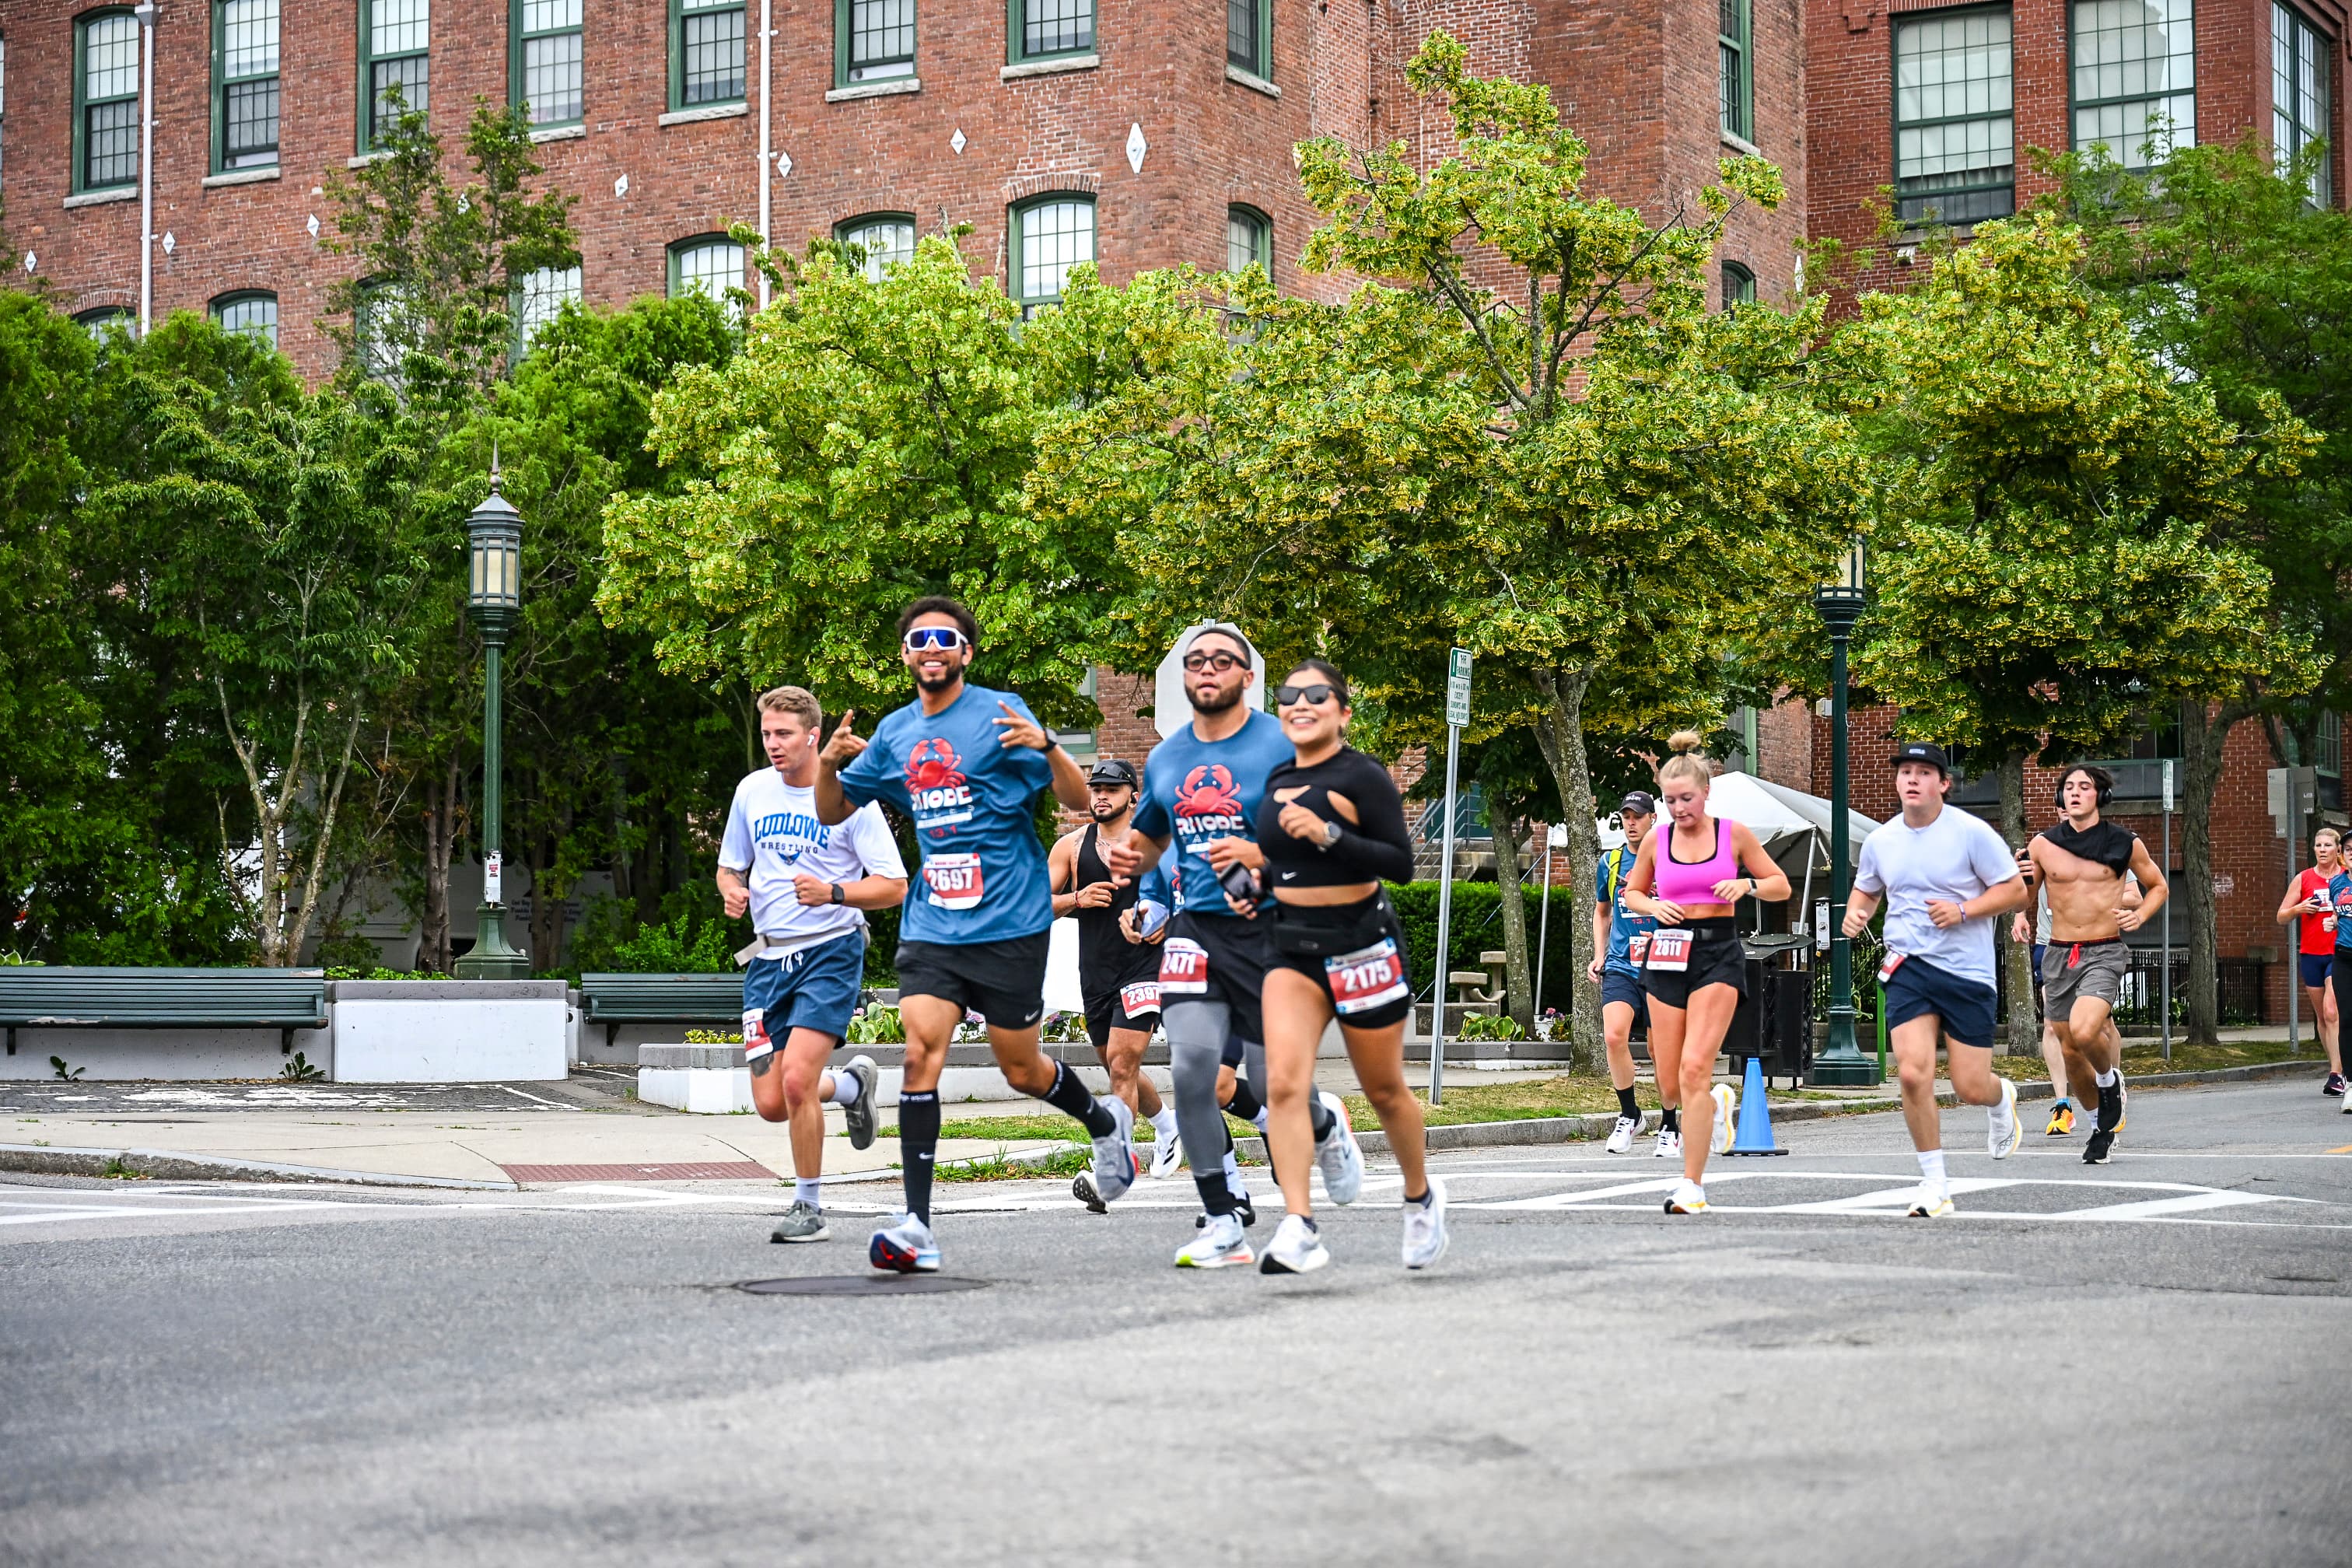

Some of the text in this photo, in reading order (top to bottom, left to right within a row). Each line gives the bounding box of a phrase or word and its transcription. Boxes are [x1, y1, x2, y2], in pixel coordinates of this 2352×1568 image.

[754, 812, 831, 851] LUDLOWE
[760, 841, 819, 855] WRESTLING
[927, 867, 973, 892] 2697
[1654, 939, 1682, 957] 2811
[1340, 958, 1392, 993] 2175
